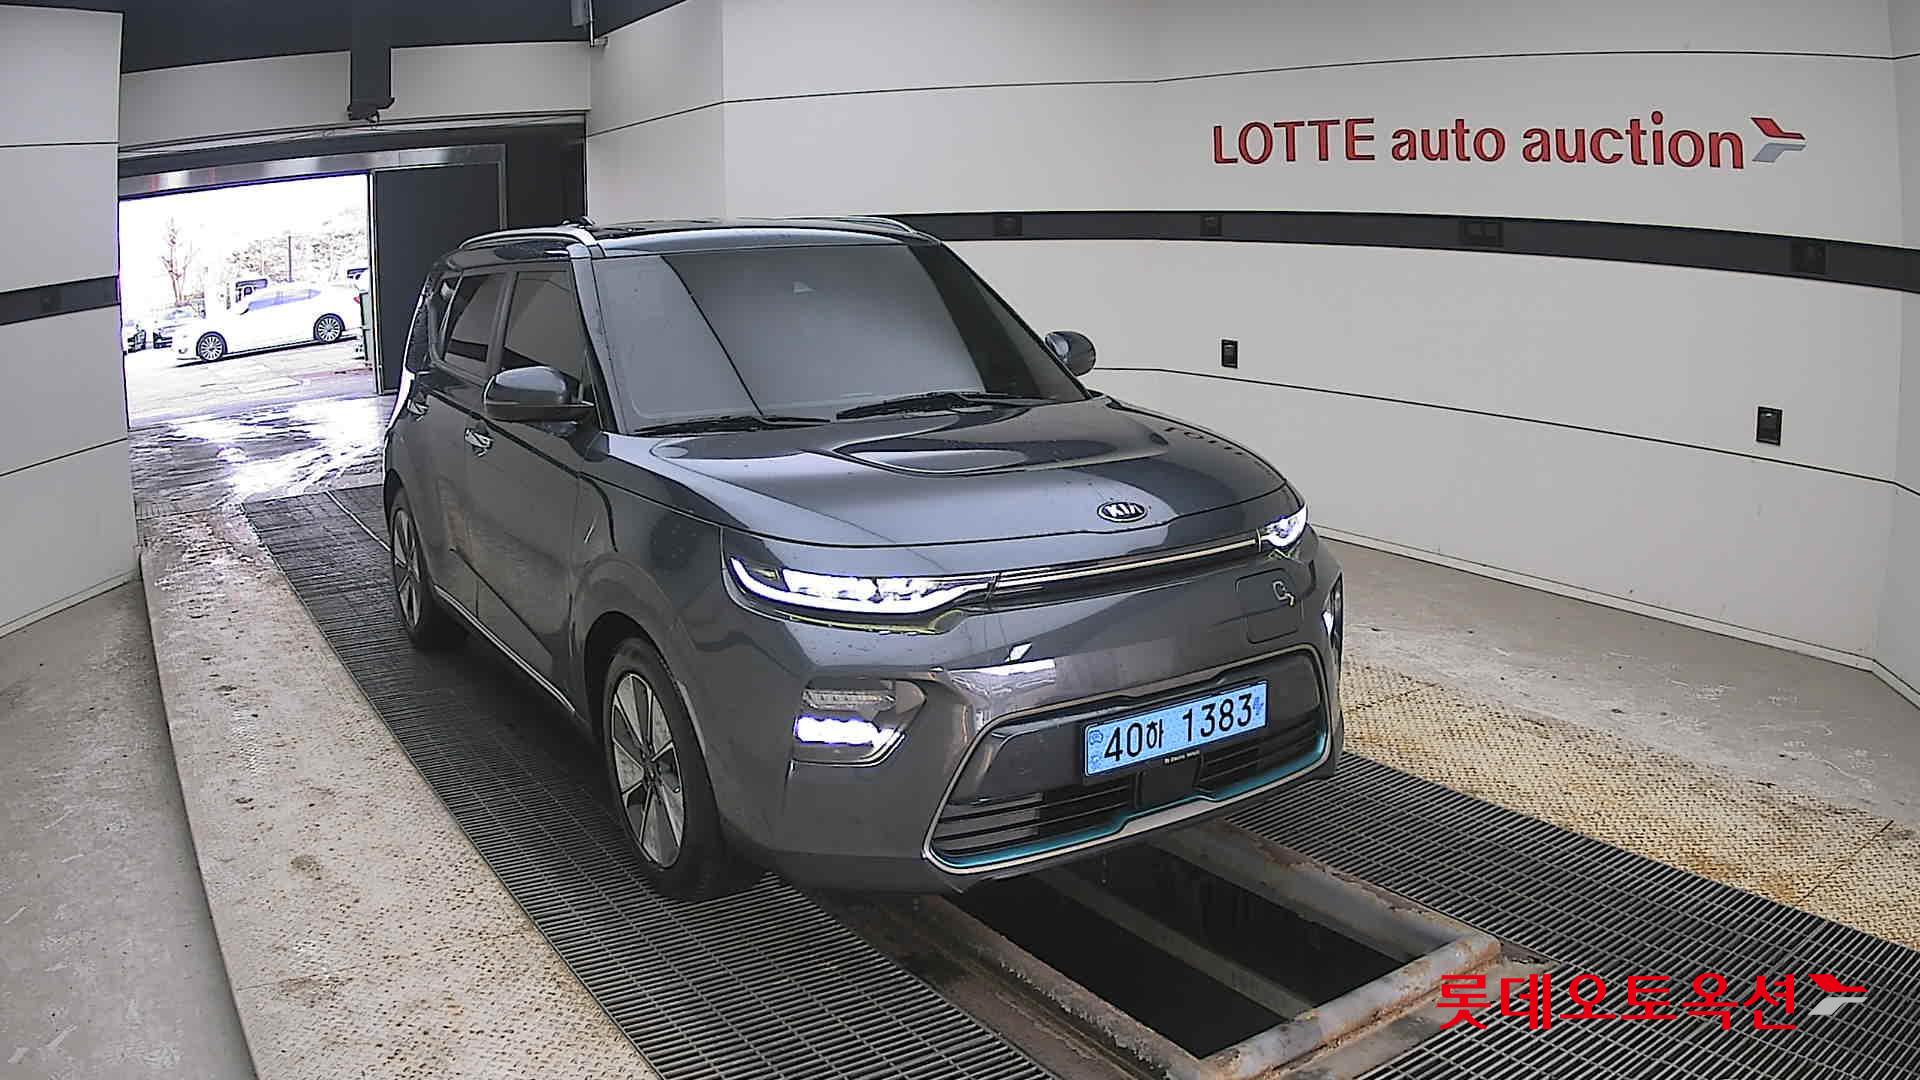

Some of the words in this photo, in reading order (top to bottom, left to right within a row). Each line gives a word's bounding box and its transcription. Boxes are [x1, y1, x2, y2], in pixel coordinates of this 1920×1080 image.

[1213, 118, 1375, 163] LOTTE
[1391, 118, 1506, 162] auto
[1522, 111, 1744, 170] auction
[1102, 502, 1144, 518] KIA
[1103, 718, 1165, 761] 40하
[1182, 692, 1253, 743] 1383
